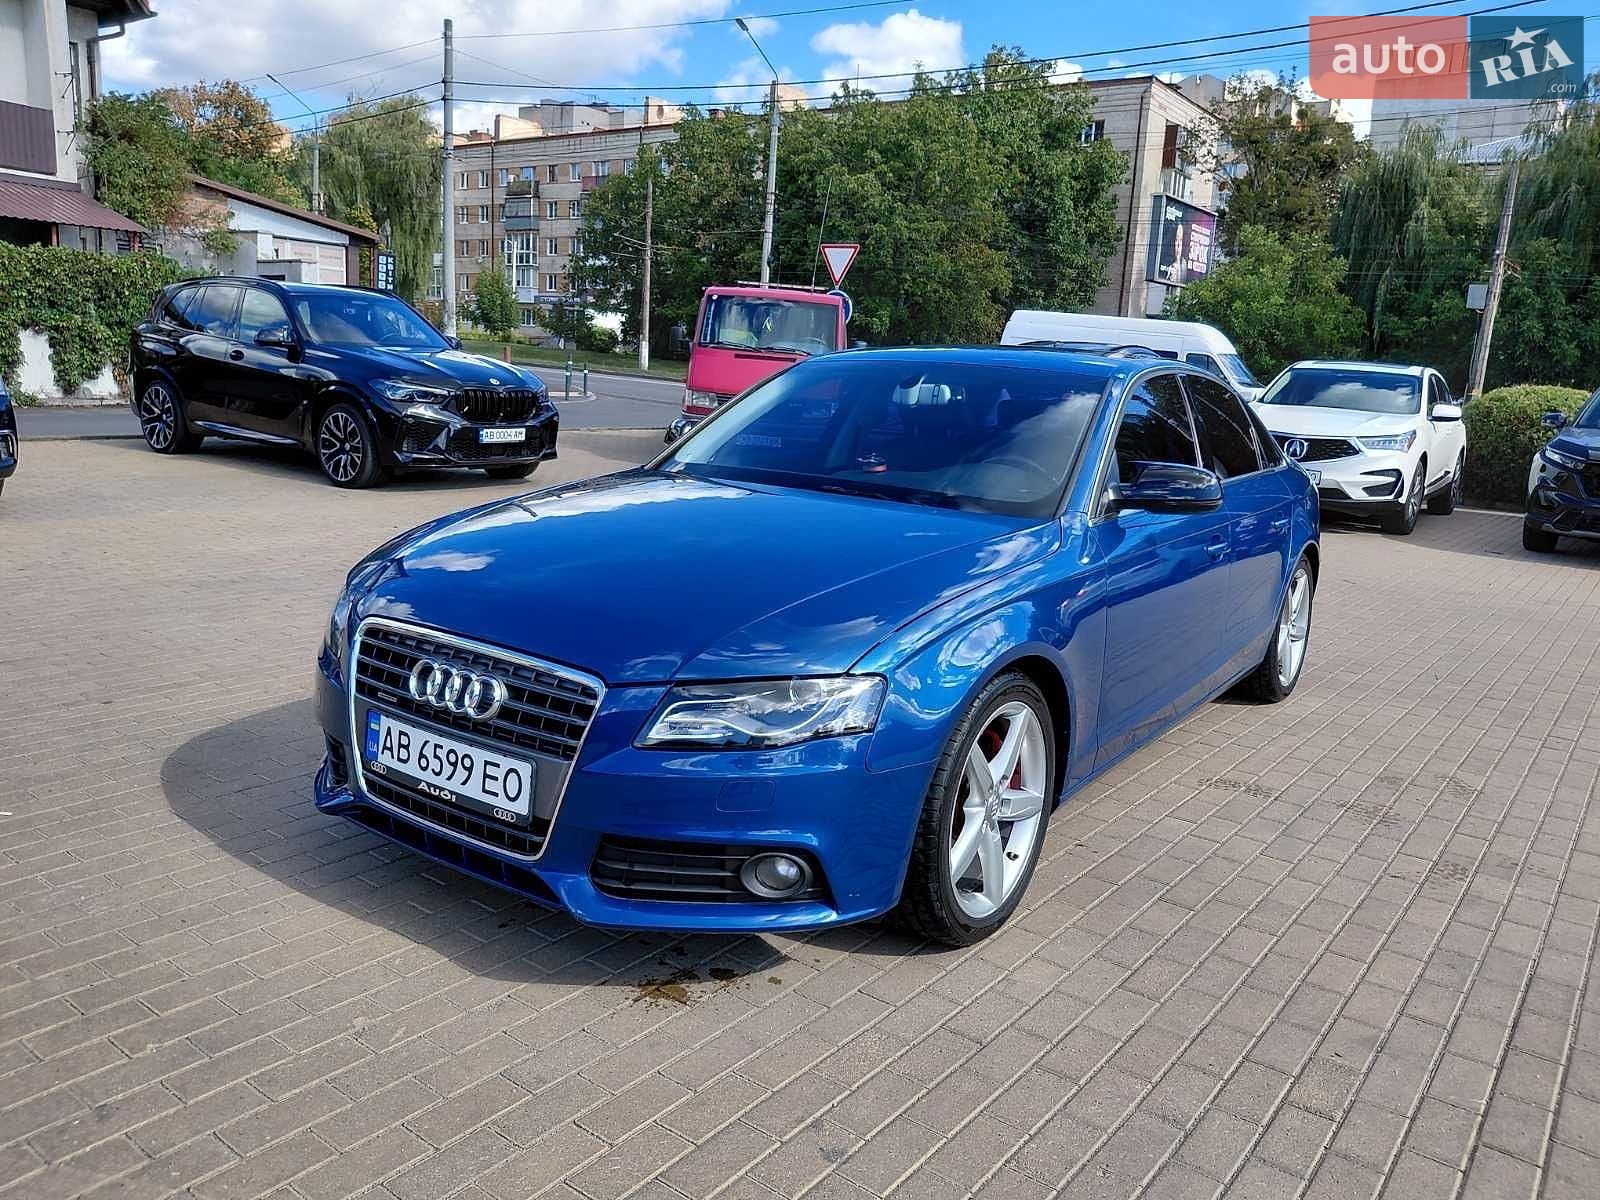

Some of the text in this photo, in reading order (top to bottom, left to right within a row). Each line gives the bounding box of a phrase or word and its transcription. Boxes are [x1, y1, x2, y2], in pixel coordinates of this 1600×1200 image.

[381, 726, 523, 802] AB 6599 EO
[417, 781, 456, 802] Audi
